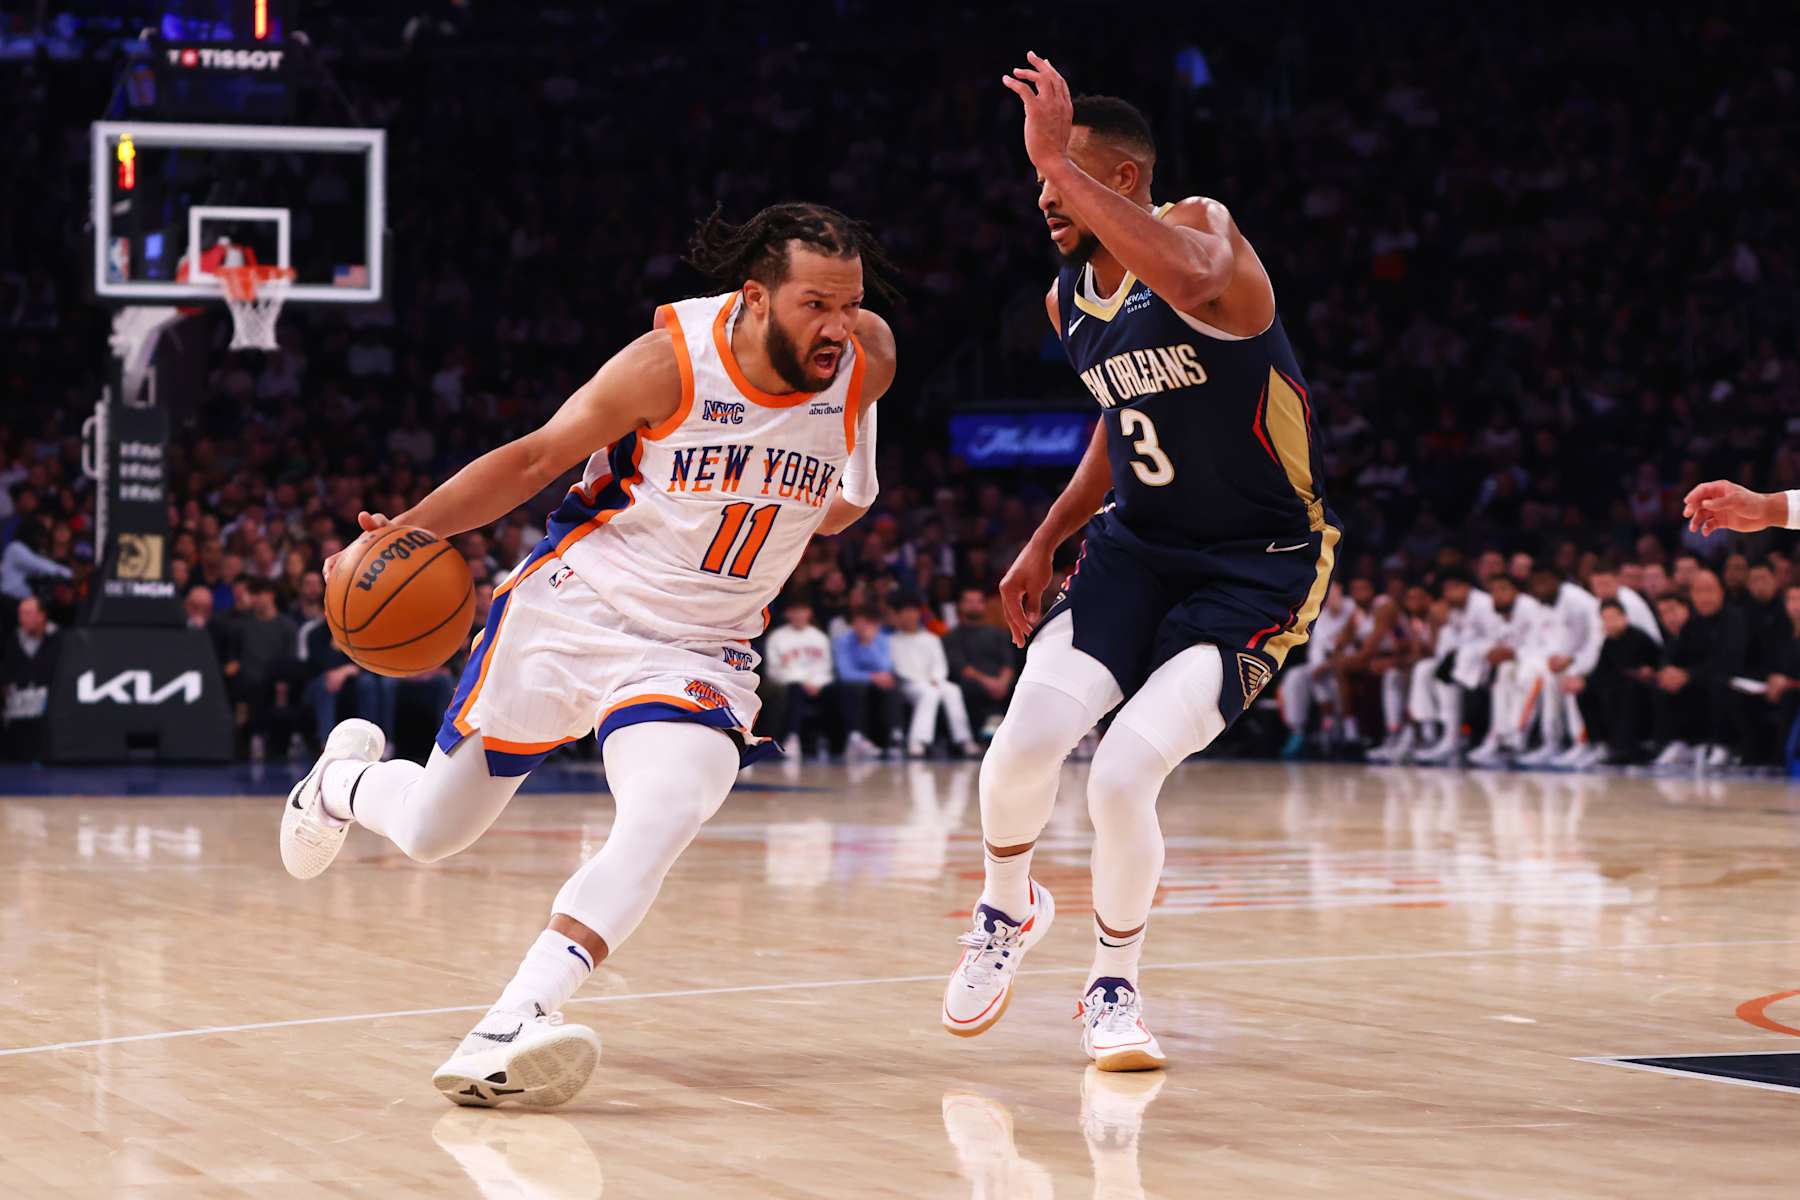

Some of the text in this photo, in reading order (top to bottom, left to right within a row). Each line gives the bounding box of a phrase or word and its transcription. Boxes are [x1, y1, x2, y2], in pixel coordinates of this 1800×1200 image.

[201, 50, 283, 69] TISSOT
[1080, 344, 1207, 408] EW ORLEANS
[703, 400, 745, 424] NYC
[667, 445, 836, 508] NEW YORK
[1120, 408, 1174, 486] 3
[356, 529, 438, 592] Wilson
[700, 502, 781, 579] 11
[78, 670, 202, 704] KIA
